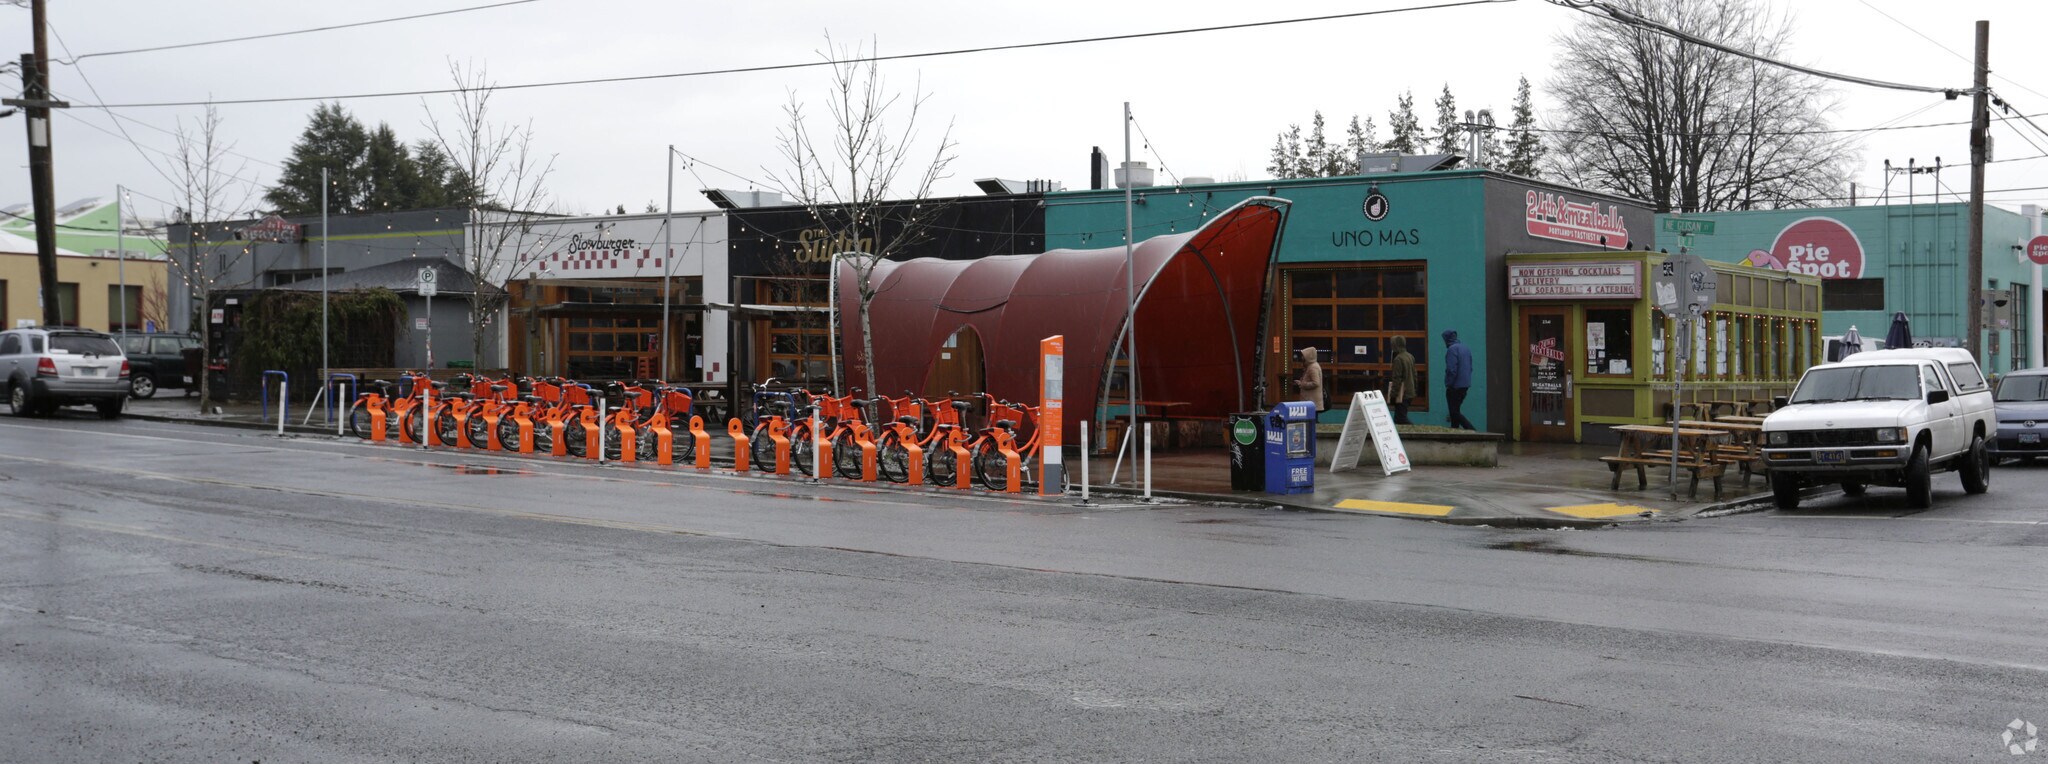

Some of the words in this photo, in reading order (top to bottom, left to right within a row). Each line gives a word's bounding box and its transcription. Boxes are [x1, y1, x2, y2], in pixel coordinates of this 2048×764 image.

[1526, 190, 1557, 220] 24th
[1557, 196, 1568, 225] &
[1567, 202, 1624, 232] meatballs
[1665, 220, 1674, 230] NE
[1677, 221, 1702, 232] GLISAN
[813, 229, 829, 237] THE
[1332, 230, 1373, 247] UNO
[1379, 229, 1419, 246] MAS
[1574, 230, 1597, 240] TASTIEST
[568, 234, 635, 256] Slowburger
[1788, 243, 1830, 261] Pie
[1519, 268, 1535, 277] NOW
[1537, 268, 1574, 277] OFFERING
[1578, 266, 1621, 276] COCKTAILS
[1786, 259, 1851, 278] Spot
[1523, 277, 1560, 286] DELIVERY
[1513, 286, 1529, 295] CALL
[1586, 285, 1592, 293] 4
[1595, 285, 1634, 295] CATERING
[1291, 467, 1308, 475] FREE
